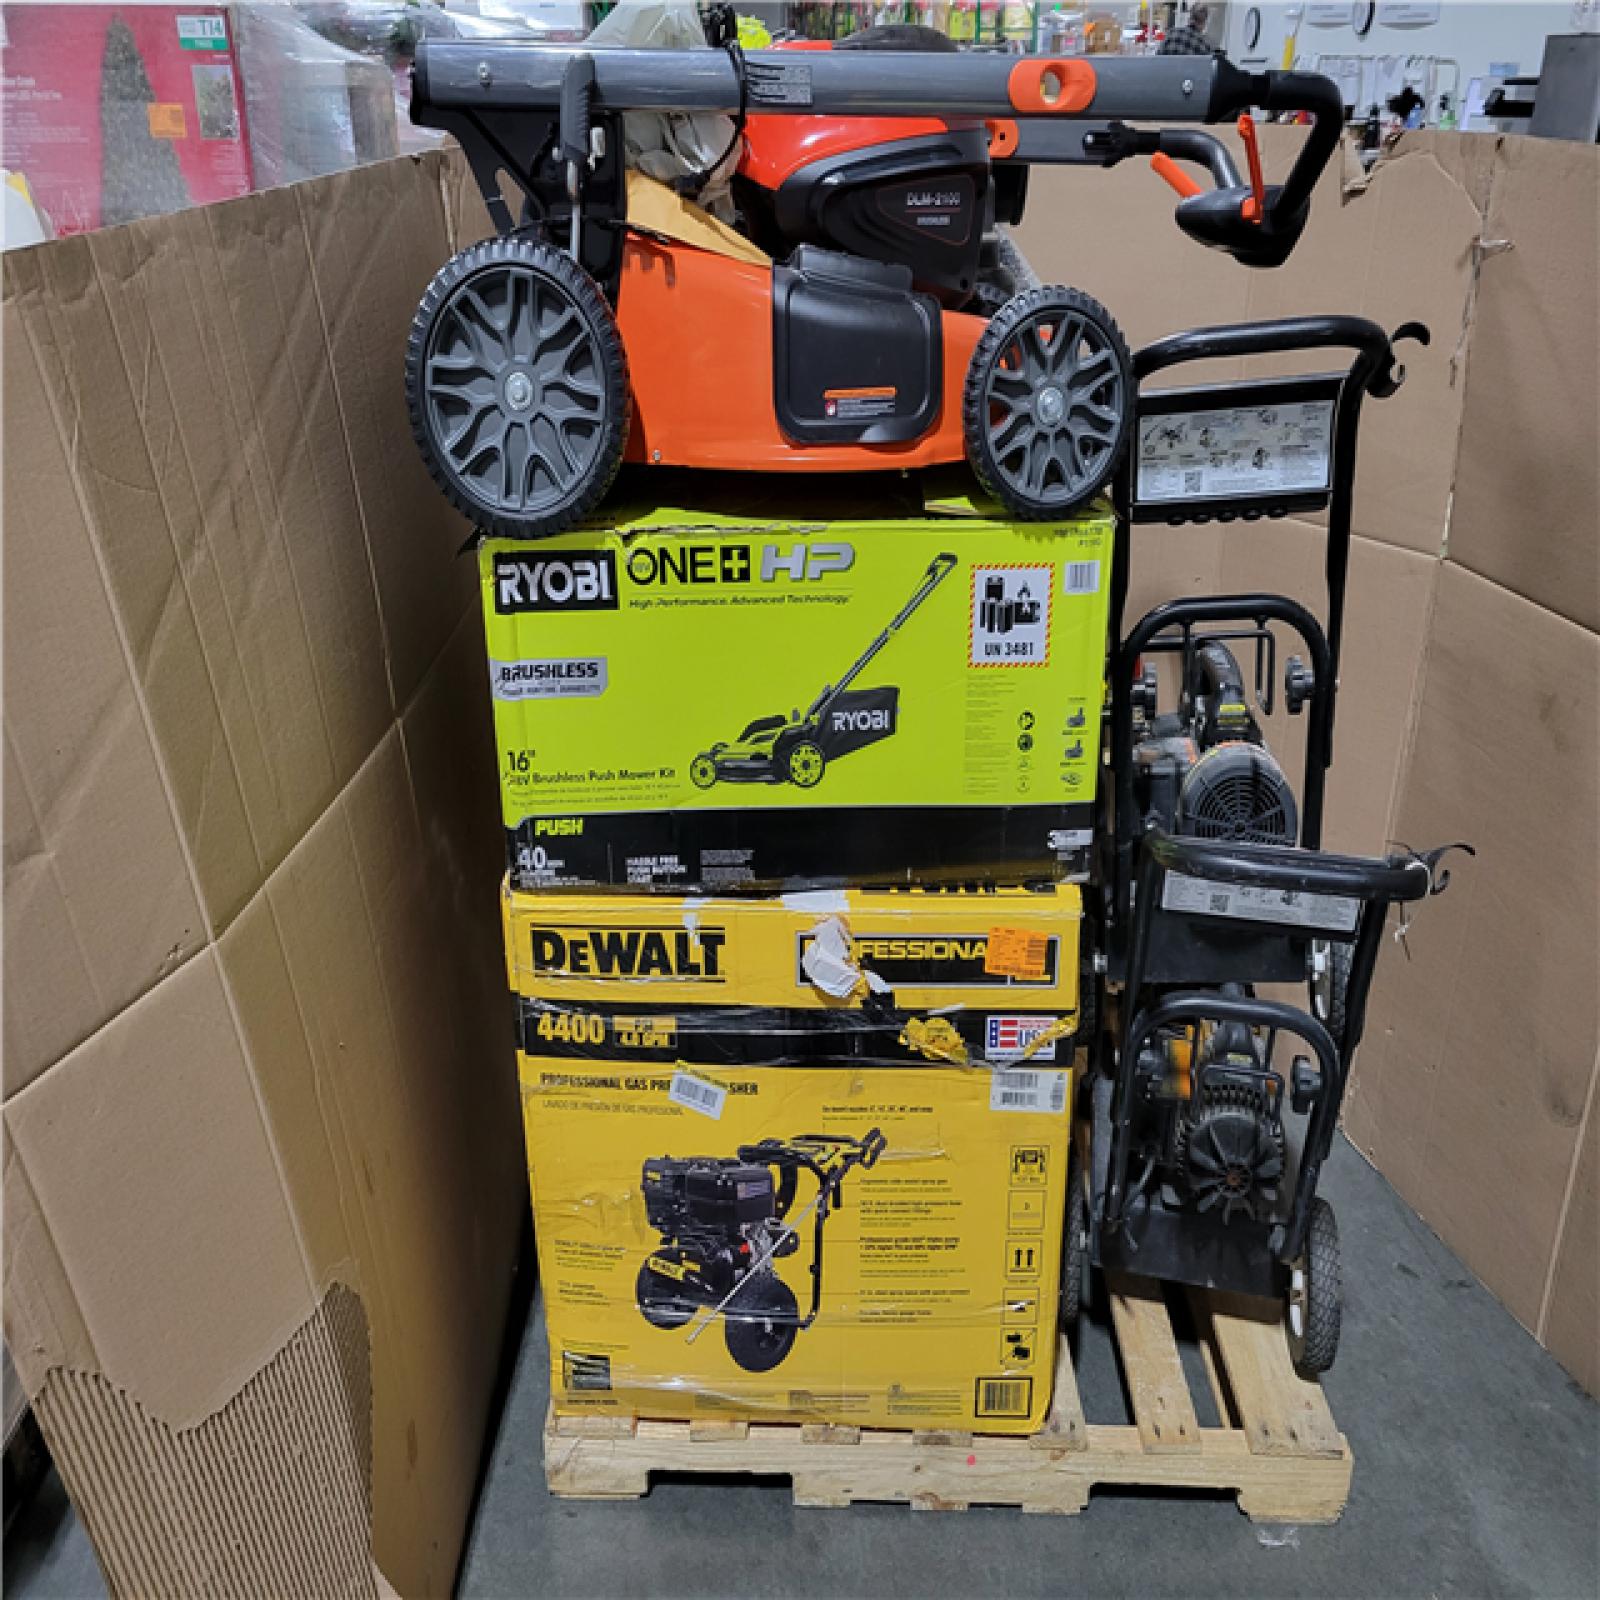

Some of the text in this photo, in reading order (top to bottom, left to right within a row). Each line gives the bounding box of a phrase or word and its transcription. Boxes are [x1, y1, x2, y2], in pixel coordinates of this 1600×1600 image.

[760, 542, 855, 581] HP
[496, 559, 614, 607] RYOBI
[984, 641, 1034, 656] UN 3481
[501, 661, 599, 682] BRUSHLESS
[831, 709, 889, 731] RYOBI
[533, 771, 585, 784] Brushless
[589, 769, 615, 780] Push
[619, 768, 655, 779] Mower
[659, 767, 676, 778] Kit
[535, 817, 584, 836] PUSH
[537, 1011, 606, 1045] 4400
